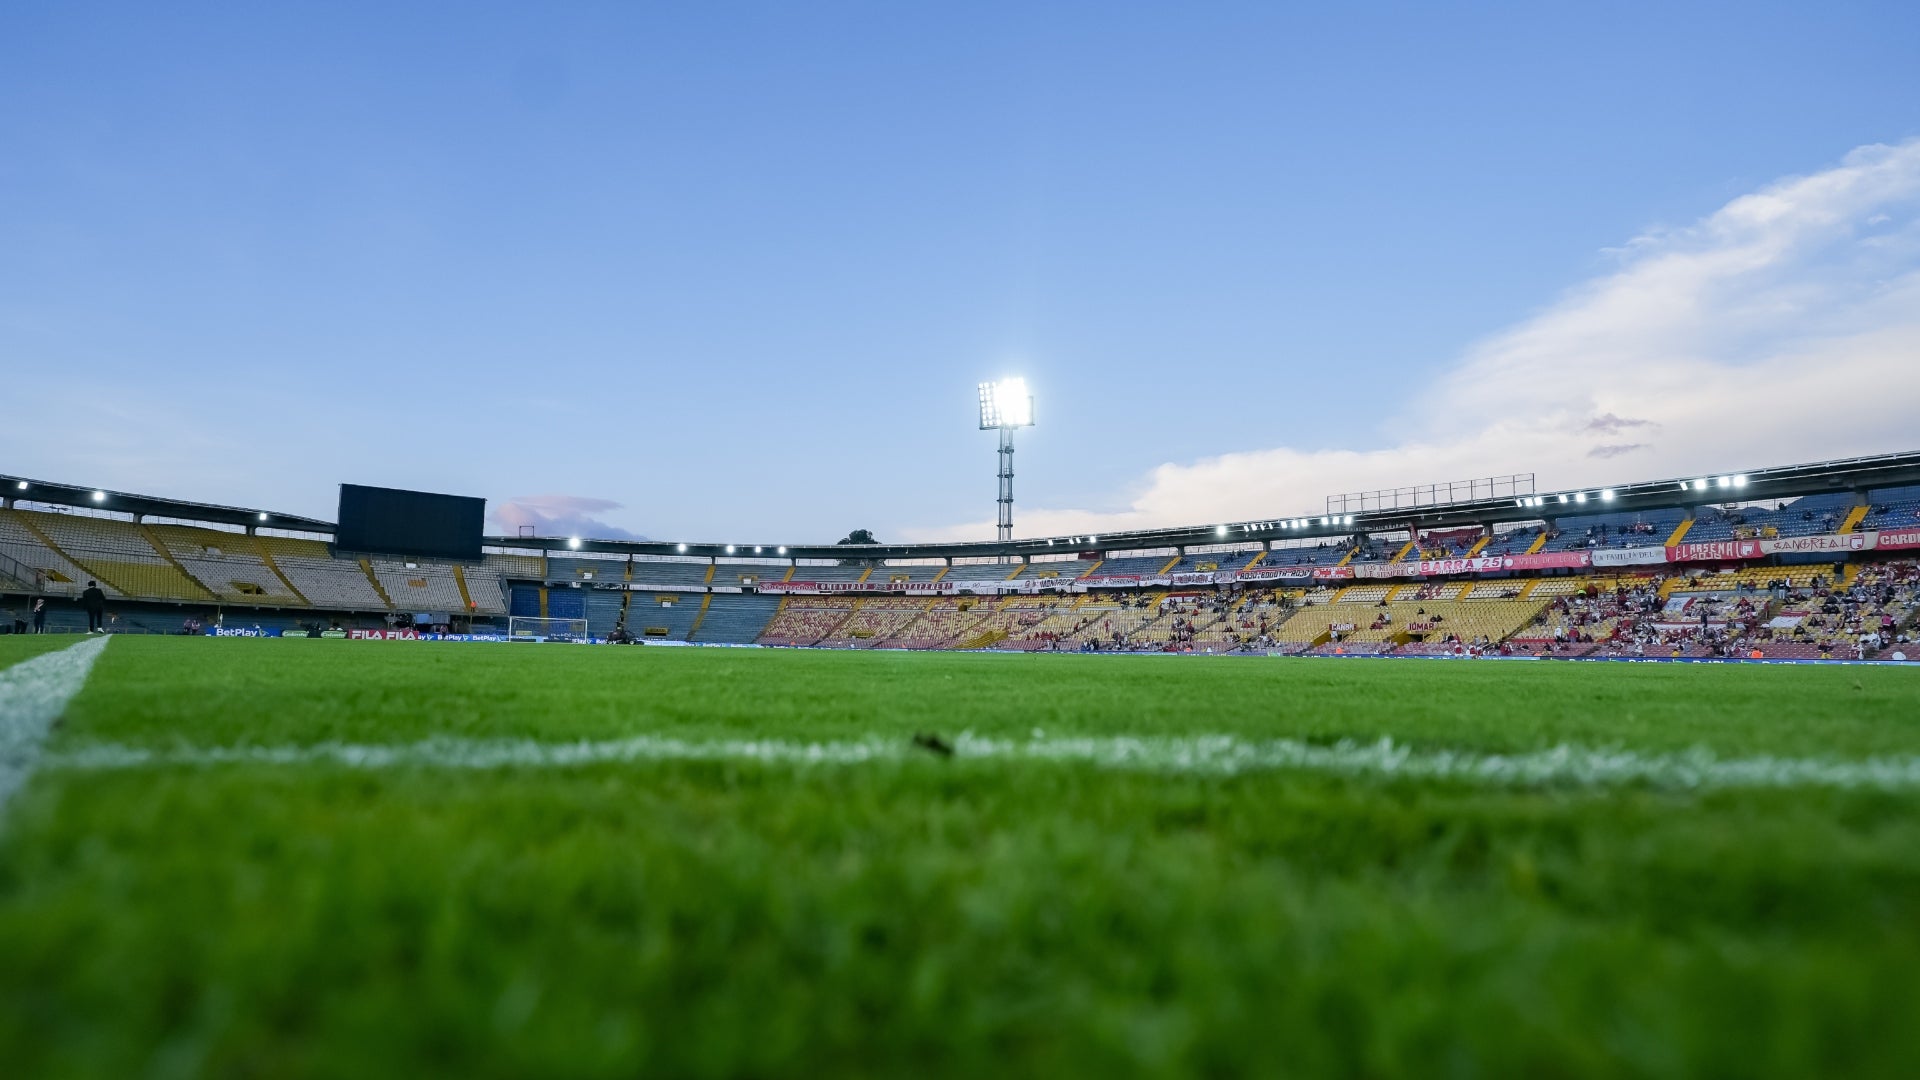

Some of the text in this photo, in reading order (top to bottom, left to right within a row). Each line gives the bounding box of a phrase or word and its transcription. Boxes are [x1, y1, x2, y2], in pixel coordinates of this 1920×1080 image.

[1676, 542, 1742, 561] EL ARSENAL
[1420, 560, 1474, 572] BARRA
[1481, 557, 1500, 568] 25
[216, 628, 257, 637] BetPlay
[351, 631, 382, 640] FILA
[386, 631, 416, 640] FILA
